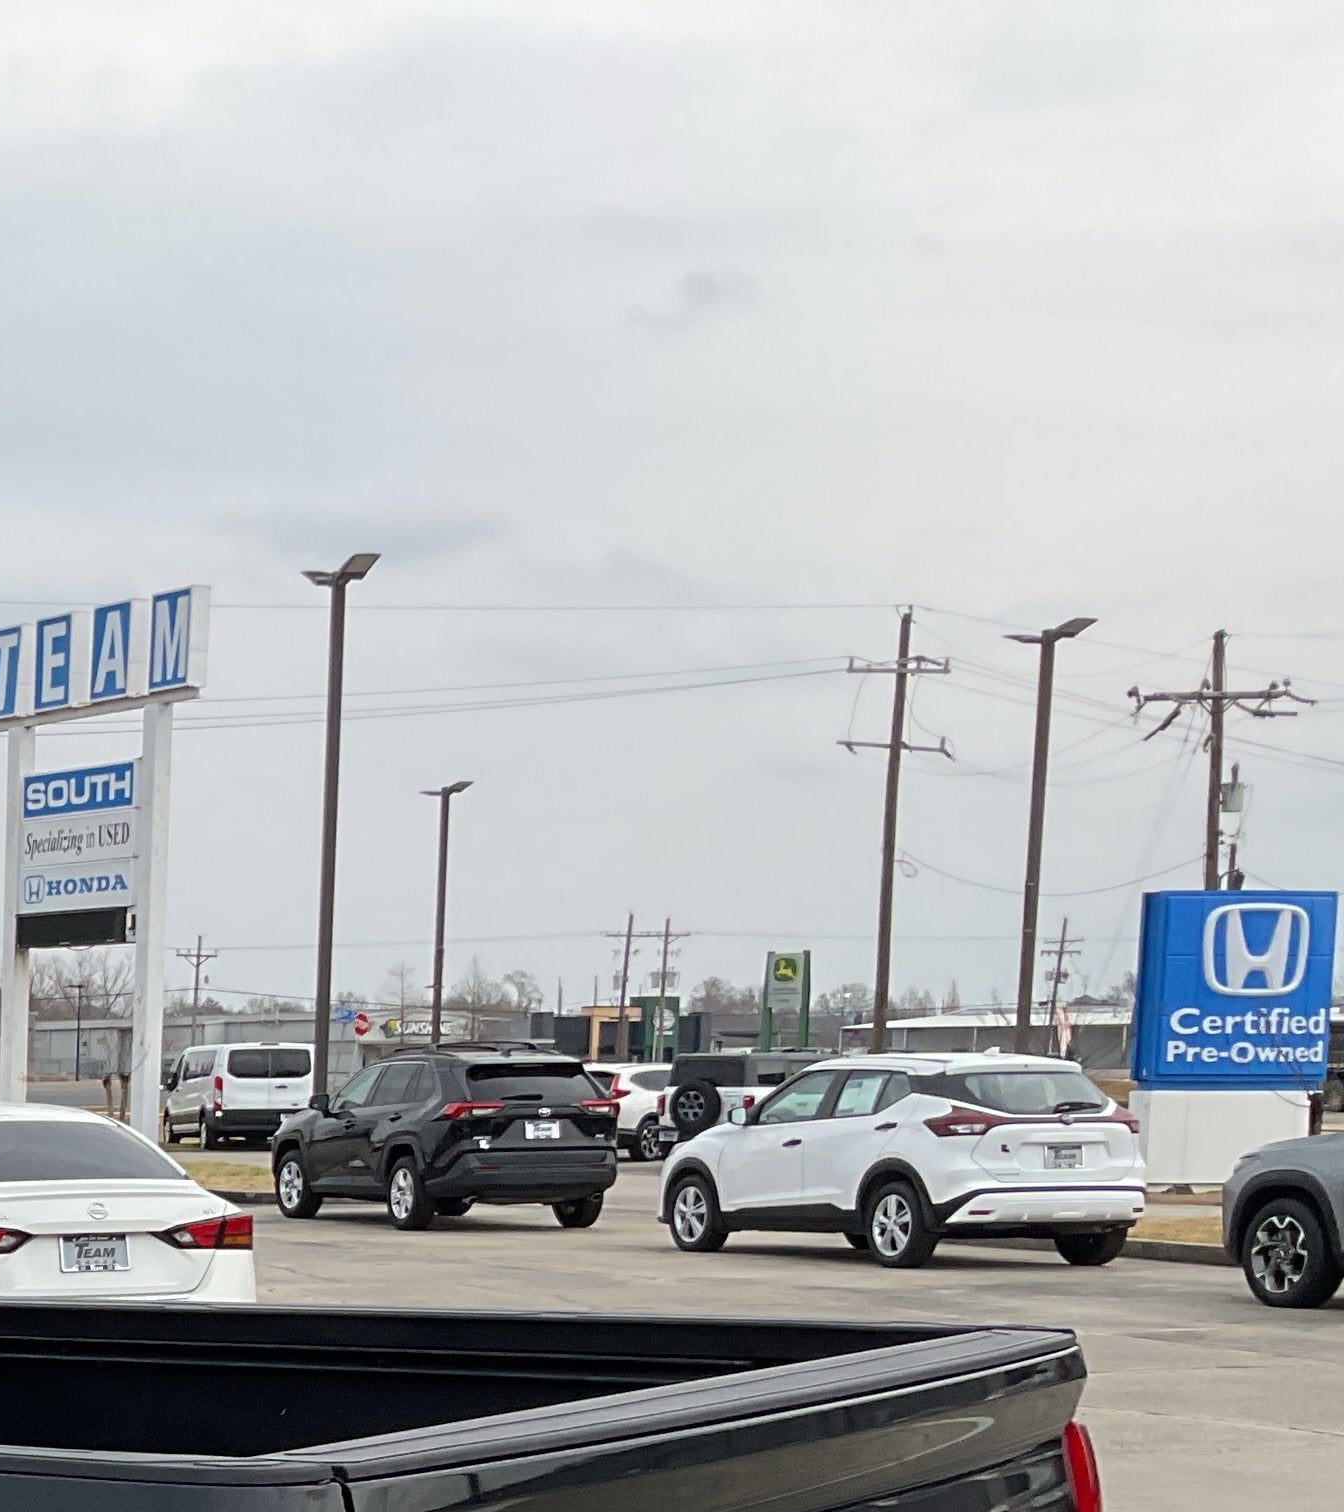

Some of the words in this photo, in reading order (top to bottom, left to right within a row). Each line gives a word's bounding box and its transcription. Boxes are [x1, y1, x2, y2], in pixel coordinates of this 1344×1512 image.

[26, 769, 131, 811] SOUTH
[25, 829, 83, 860] Specializing
[86, 826, 95, 848] in
[98, 822, 130, 847] USED
[46, 874, 128, 896] HONDA
[395, 1019, 453, 1034] SUNSHNE
[1169, 1008, 1326, 1035] Certified
[1165, 1040, 1324, 1063] Pre-Owned
[74, 1242, 116, 1259] TEAM
